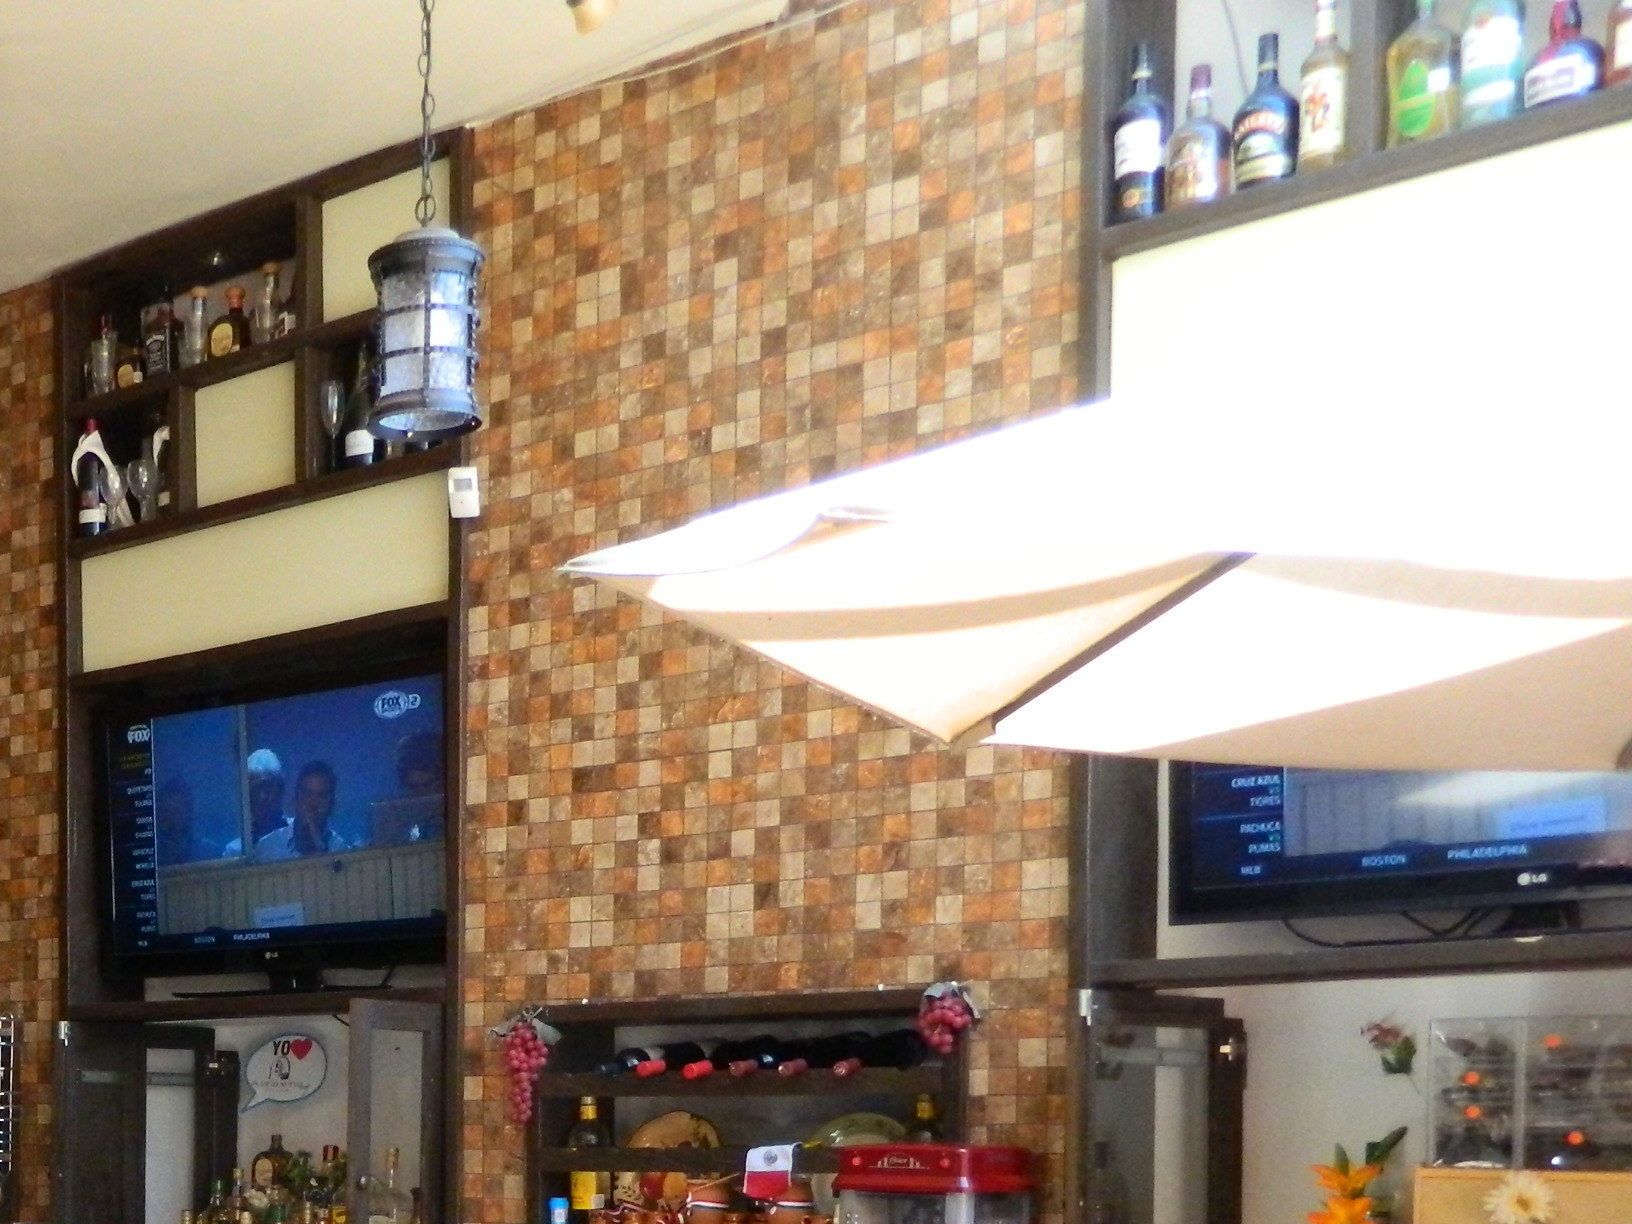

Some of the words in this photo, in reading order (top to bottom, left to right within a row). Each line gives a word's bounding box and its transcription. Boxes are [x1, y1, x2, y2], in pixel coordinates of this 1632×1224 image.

[127, 729, 151, 743] FOX
[1447, 844, 1527, 859] PHILADELPHIA
[1362, 854, 1406, 867] BOSTON
[272, 1040, 291, 1056] YO
